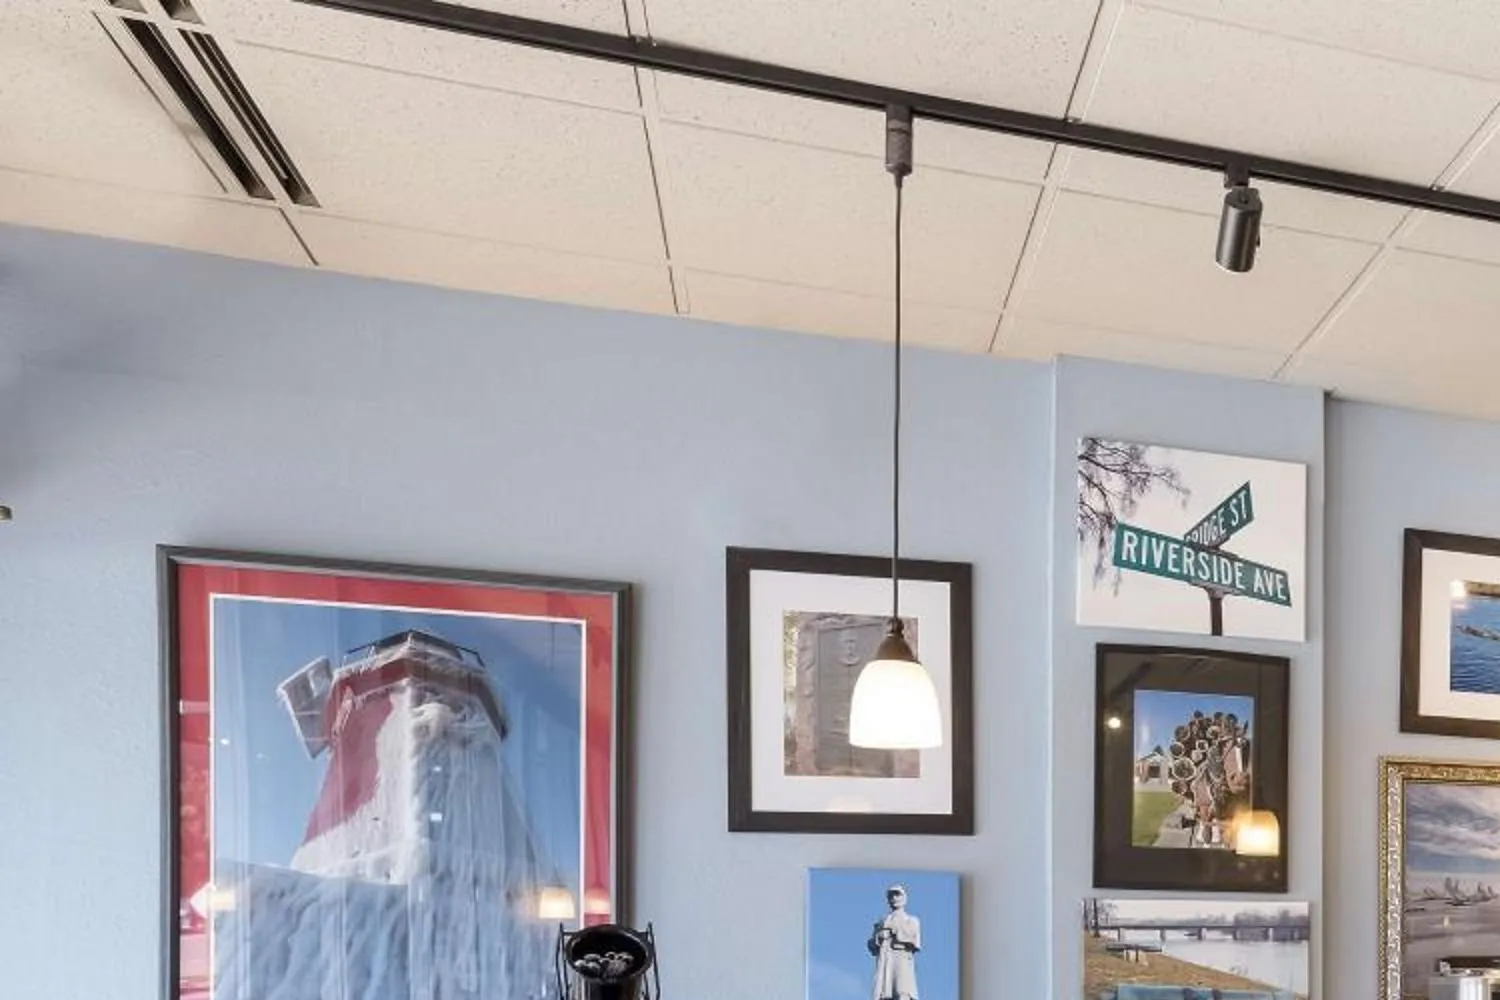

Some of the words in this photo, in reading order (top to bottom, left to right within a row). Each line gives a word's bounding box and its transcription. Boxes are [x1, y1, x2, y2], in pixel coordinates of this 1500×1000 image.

[1230, 490, 1248, 526] ST
[1121, 529, 1247, 590] RIVERSIDE
[1252, 569, 1288, 601] AVE
